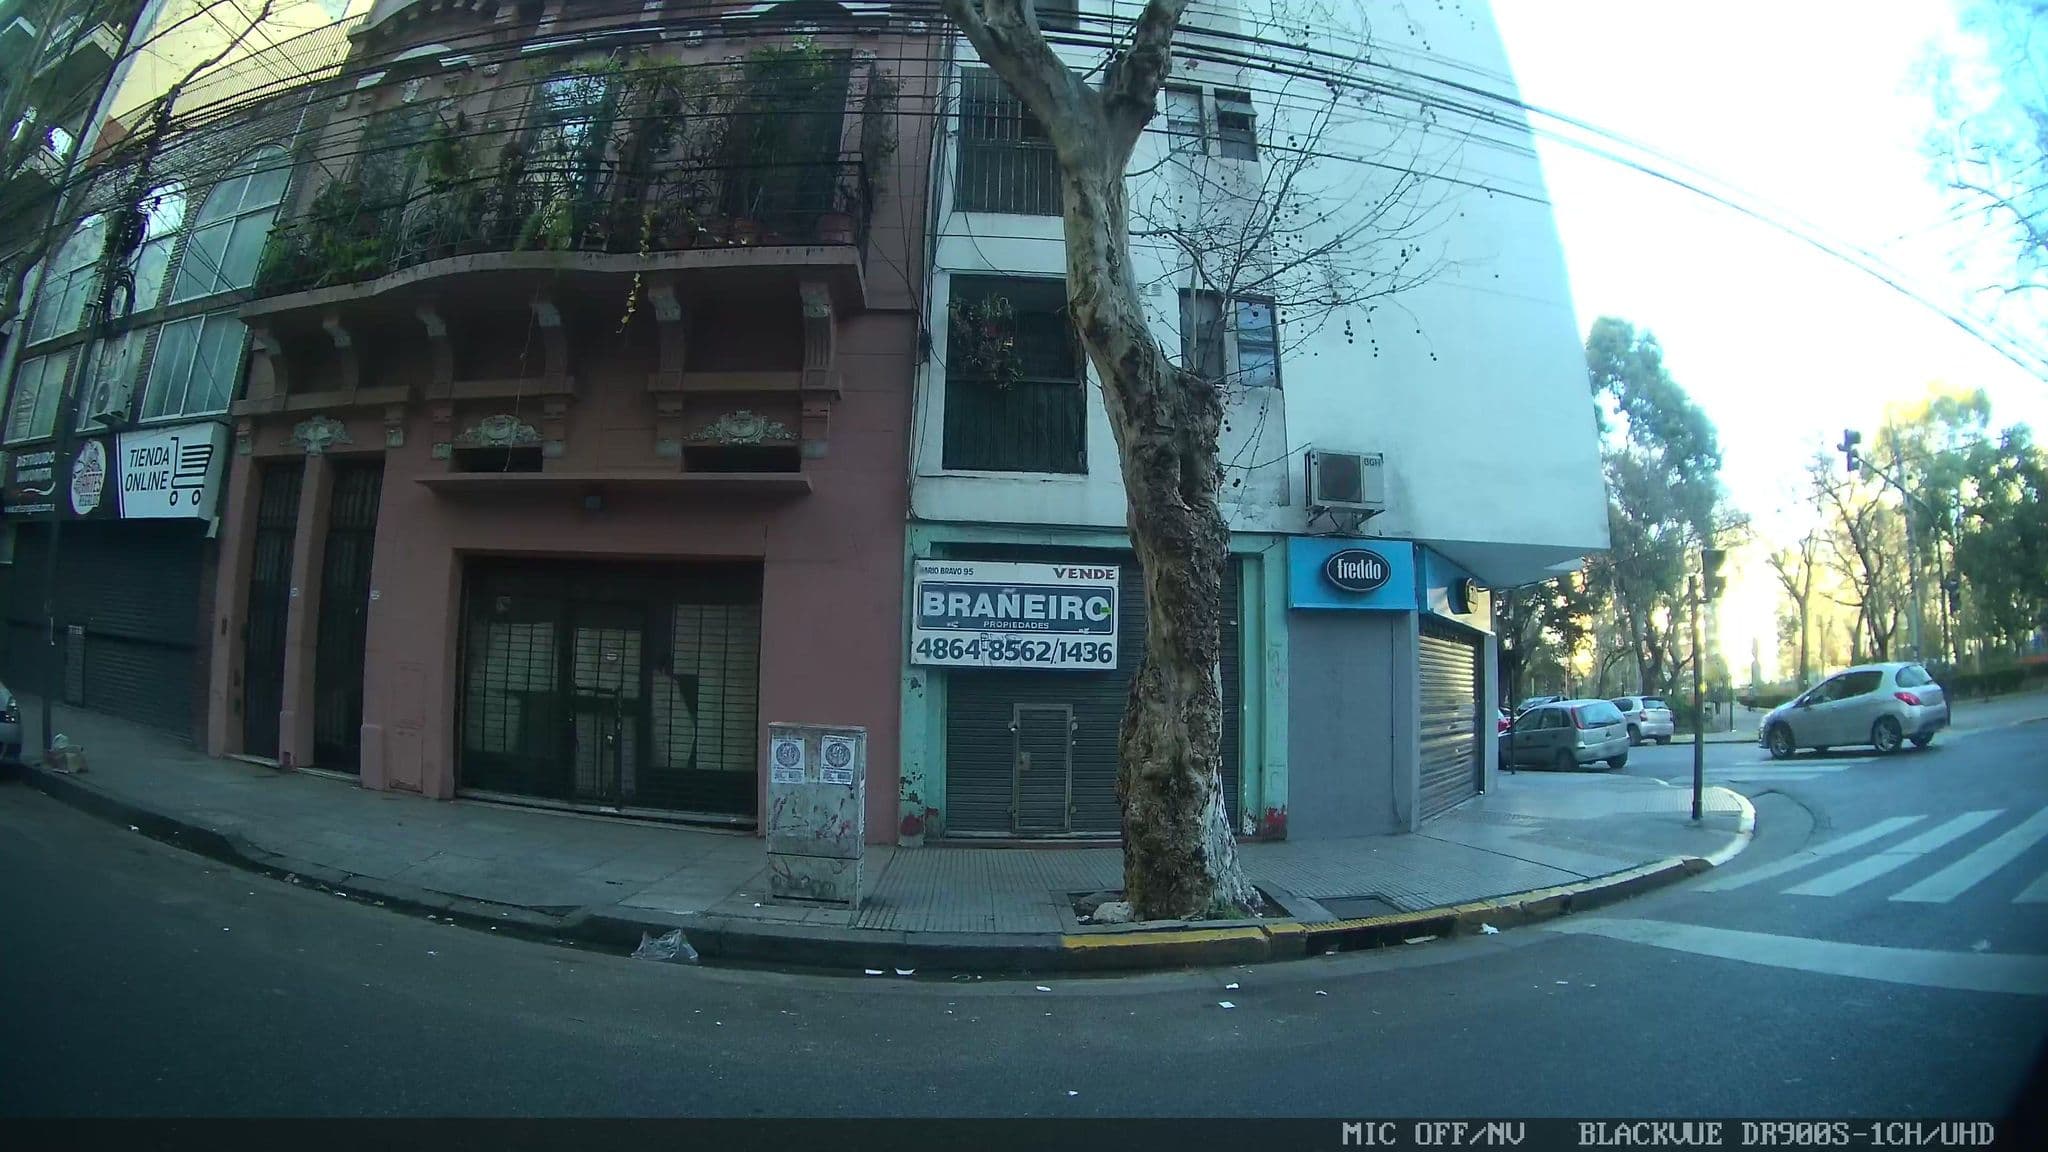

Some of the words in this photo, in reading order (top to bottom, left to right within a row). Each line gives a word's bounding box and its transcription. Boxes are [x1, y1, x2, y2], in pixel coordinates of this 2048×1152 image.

[129, 447, 170, 468] TIENDA
[125, 470, 168, 493] ONLINE
[921, 566, 939, 575] ARIO
[940, 567, 962, 575] BRAVO
[963, 567, 974, 576] 95
[1053, 567, 1115, 580] VENDE
[983, 620, 1050, 630] PROPIEDADES
[916, 637, 1113, 664] 4864-8562/1436
